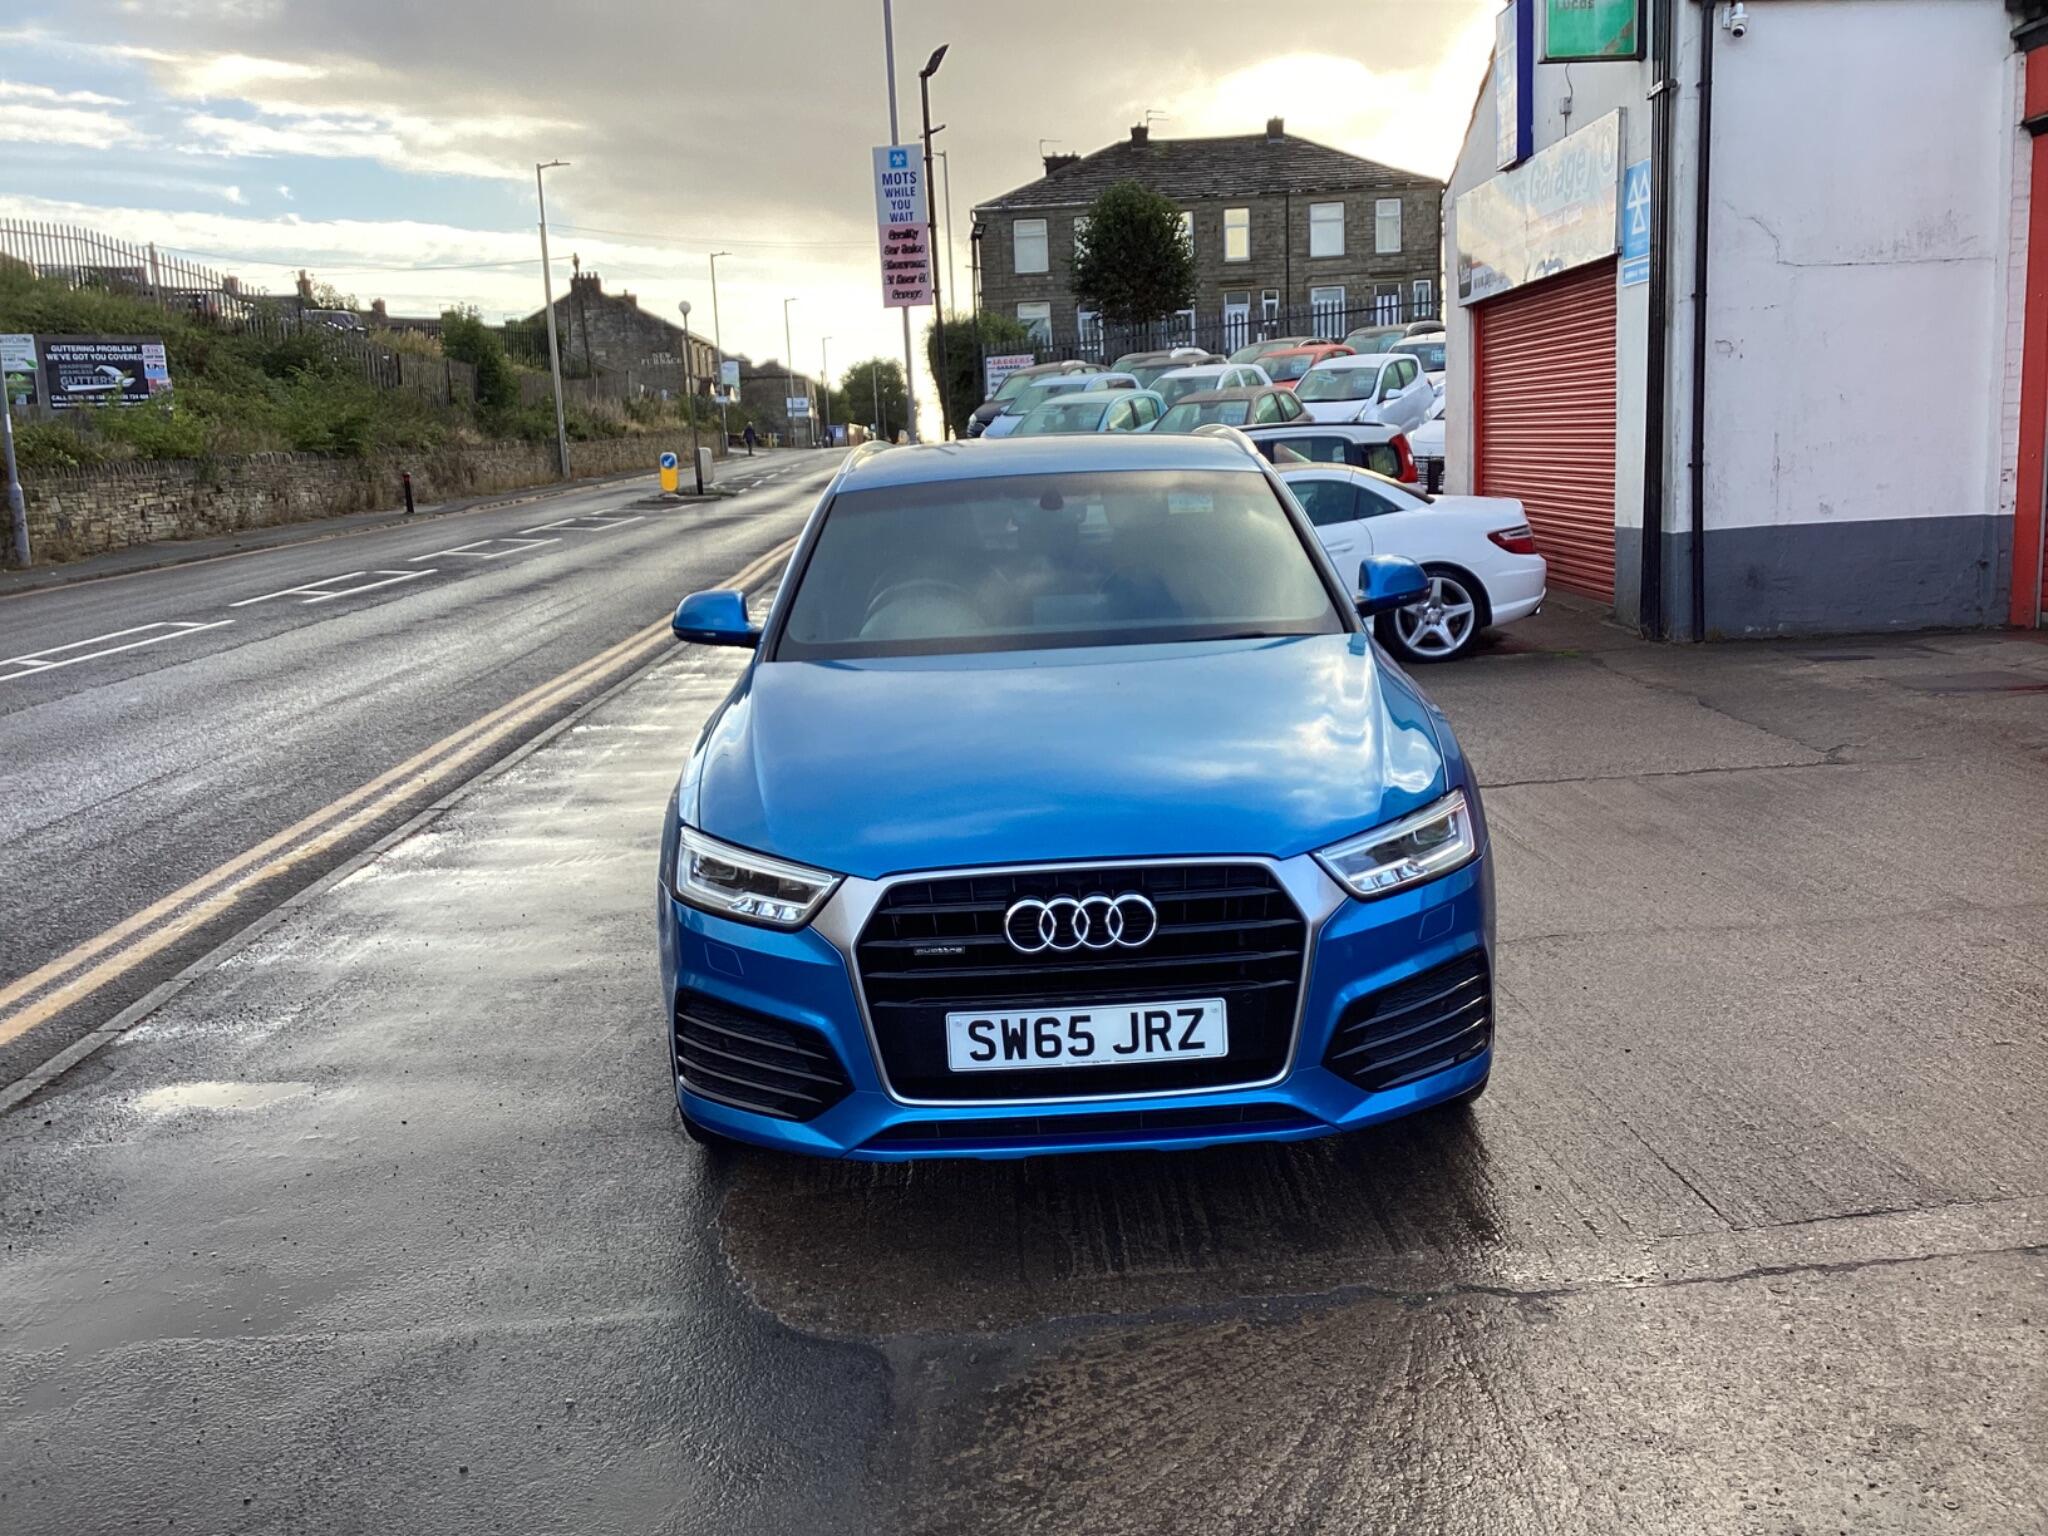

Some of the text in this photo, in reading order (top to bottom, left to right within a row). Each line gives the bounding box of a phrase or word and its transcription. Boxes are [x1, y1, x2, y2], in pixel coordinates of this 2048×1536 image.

[882, 171, 917, 185] MOTS
[884, 186, 916, 198] WHILE
[891, 199, 911, 210] YOU
[889, 211, 914, 222] WAIT
[50, 344, 137, 352] GUTTERING PROBLEM?
[60, 376, 115, 385] GUTTERS
[967, 1008, 1206, 1062] SW65 JRZ
